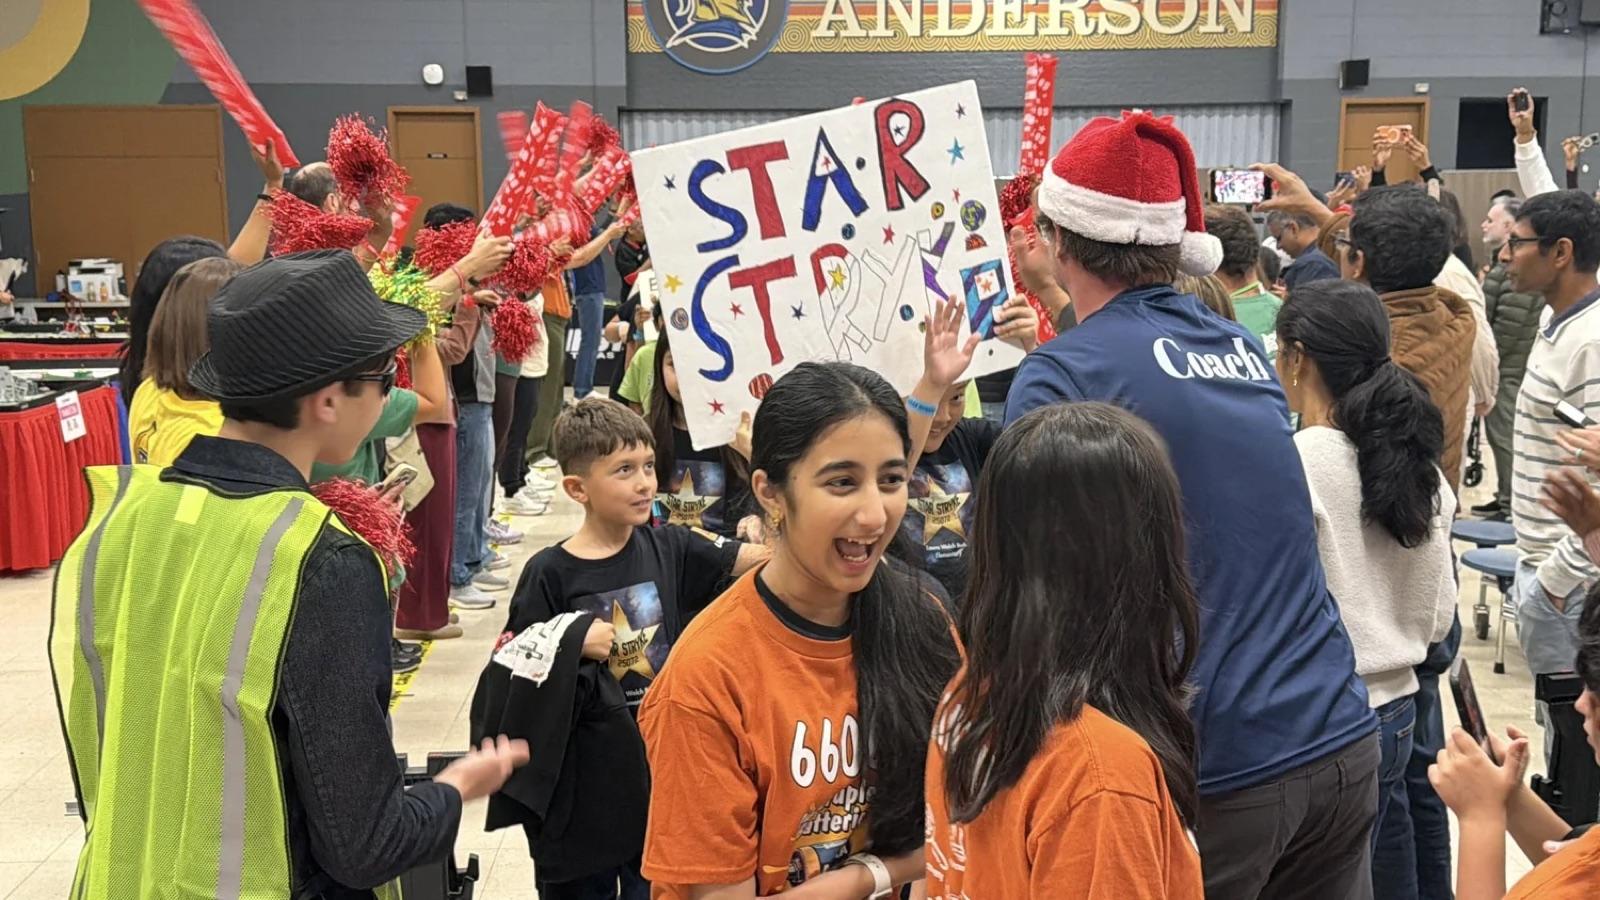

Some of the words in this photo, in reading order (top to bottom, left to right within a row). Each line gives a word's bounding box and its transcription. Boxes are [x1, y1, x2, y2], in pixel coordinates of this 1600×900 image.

[810, 0, 1255, 38] ANDERSON
[687, 98, 931, 253] STAR
[569, 351, 615, 359] TAS
[1153, 337, 1271, 381] Coach
[936, 495, 960, 515] STRYKE
[610, 642, 620, 657] AR
[621, 627, 649, 657] STRYKE
[790, 713, 878, 788] 660
[799, 806, 867, 836] atteri
